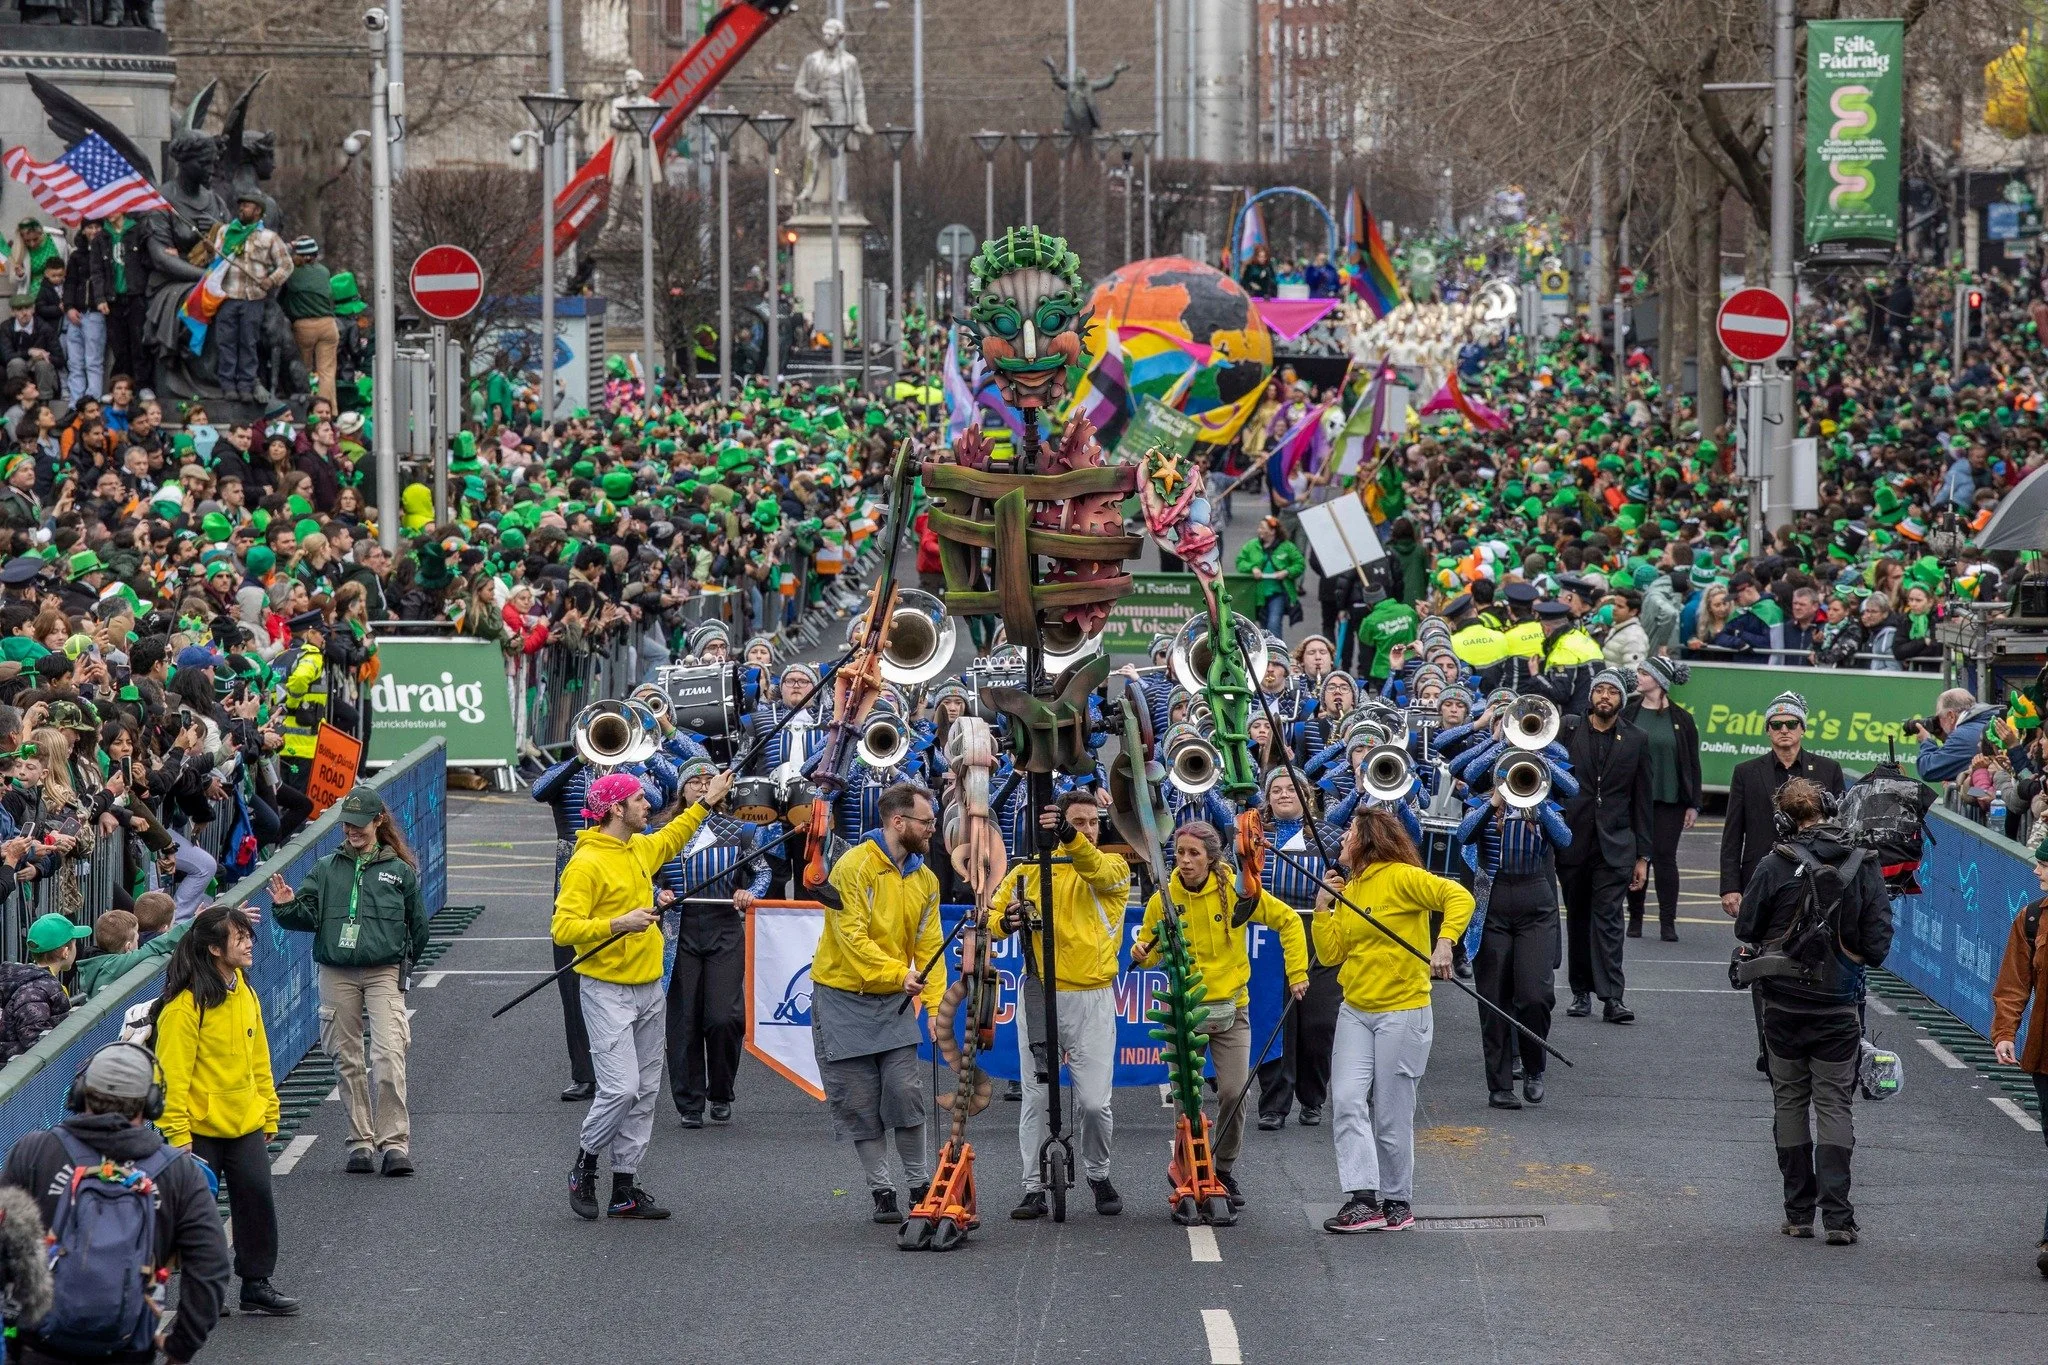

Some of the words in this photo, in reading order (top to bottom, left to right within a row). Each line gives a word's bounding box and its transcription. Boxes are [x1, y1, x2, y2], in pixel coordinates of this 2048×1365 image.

[1818, 50, 1890, 72] Pádraig
[1462, 636, 1494, 647] GARDA
[1521, 631, 1545, 642] GARD
[370, 671, 486, 724] draig
[1701, 741, 1738, 755] Dublin,
[1741, 743, 1773, 754] Irelan
[318, 763, 345, 789] ROAD
[310, 784, 337, 807] CLOS
